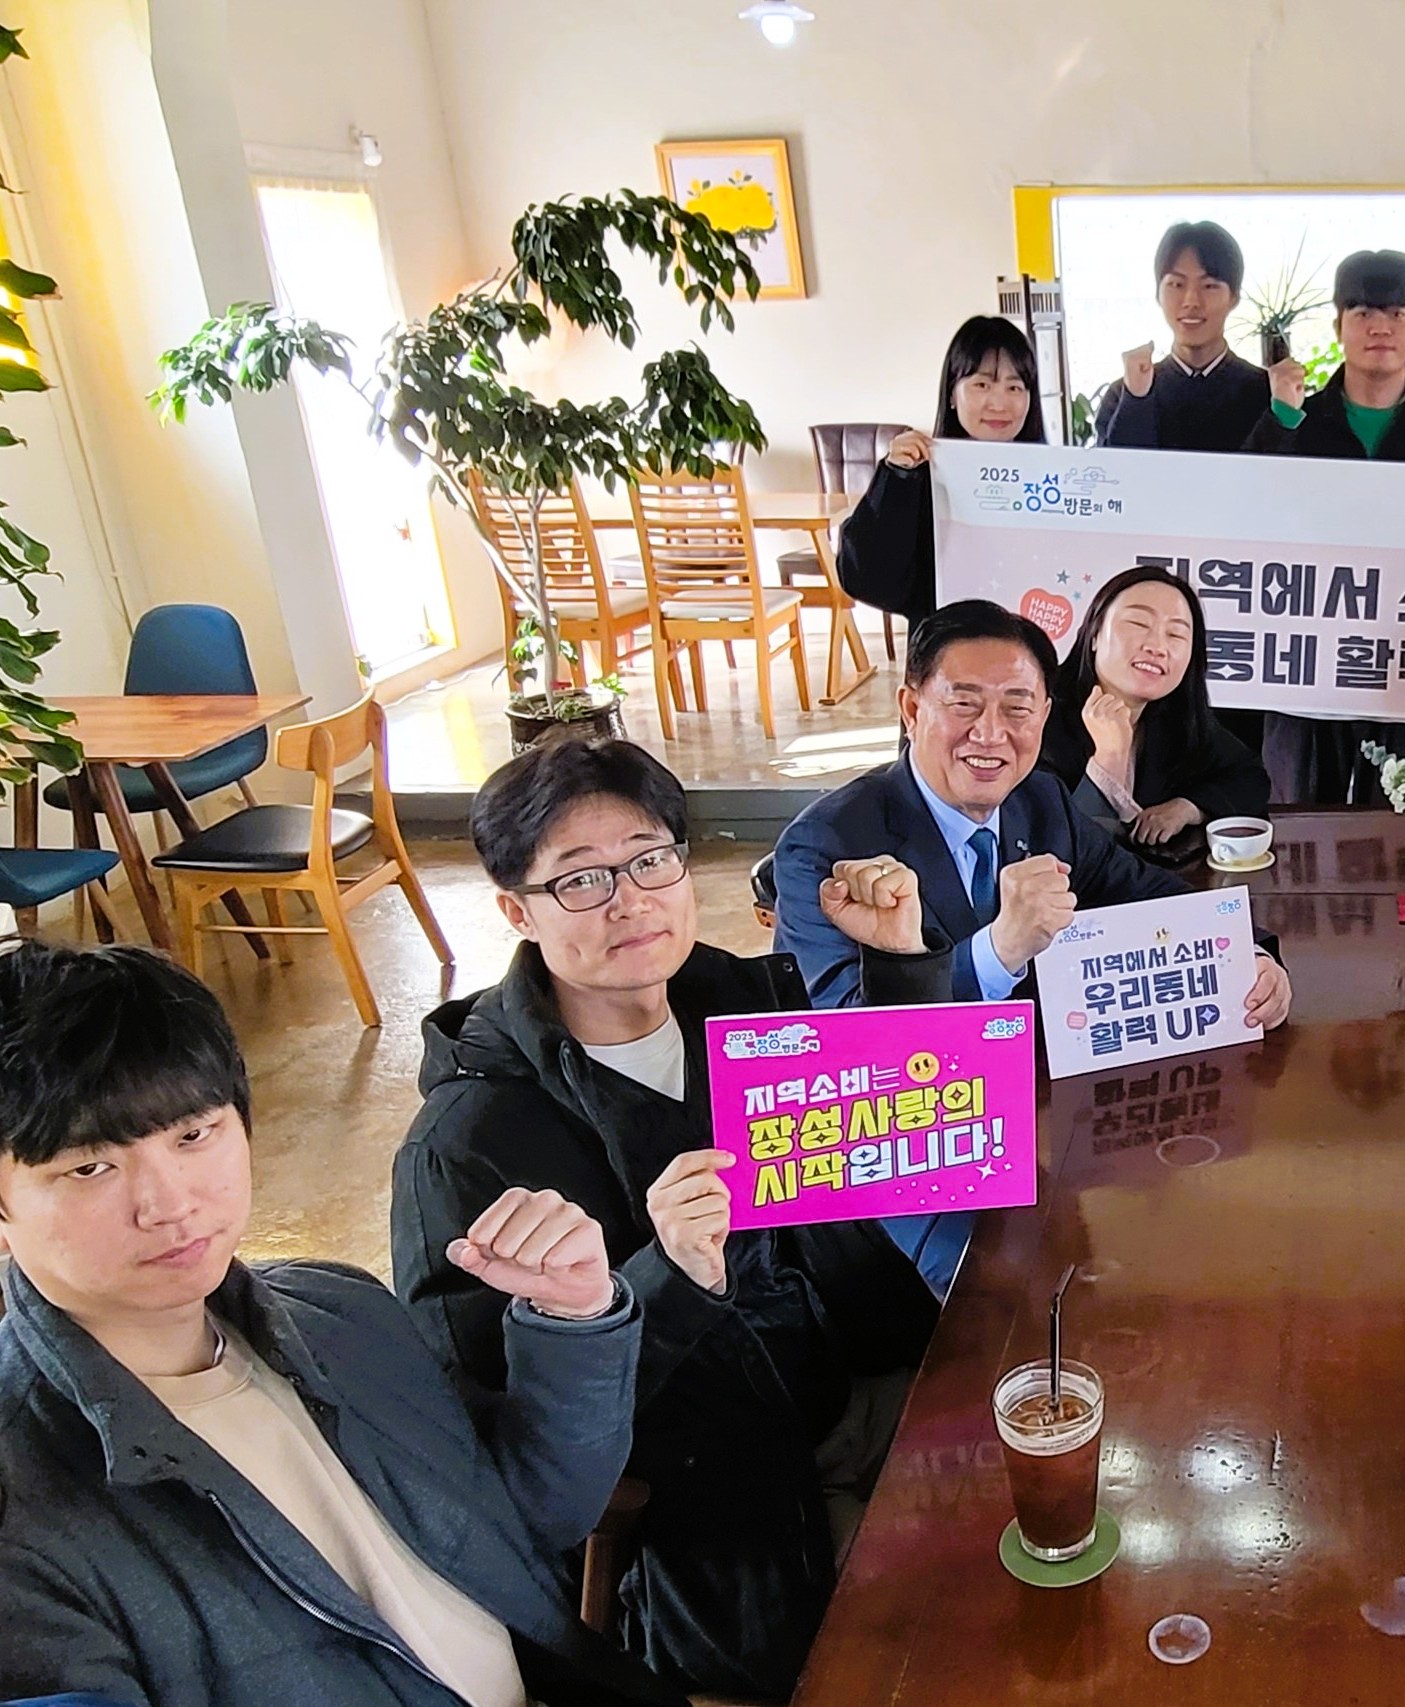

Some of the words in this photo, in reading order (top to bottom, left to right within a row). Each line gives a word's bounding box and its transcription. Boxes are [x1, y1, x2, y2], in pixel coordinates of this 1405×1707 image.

[980, 467, 1019, 482] 2025
[1024, 474, 1061, 512] 장성
[1064, 498, 1102, 516] 방문의
[1107, 499, 1122, 514] 해
[1027, 606, 1066, 627] HAPPY
[1030, 597, 1069, 617] HAPPY
[1081, 946, 1168, 980] 지역에서
[1174, 938, 1214, 964] 소비
[1085, 964, 1219, 1015] 우리동네
[729, 1032, 754, 1041] 2025
[1090, 1014, 1159, 1056] 활력
[1165, 1004, 1221, 1040] UP
[744, 1063, 900, 1116] 지역소비는
[749, 1077, 985, 1161] 장성사랑의
[753, 1117, 1006, 1207] 시작입니다!
